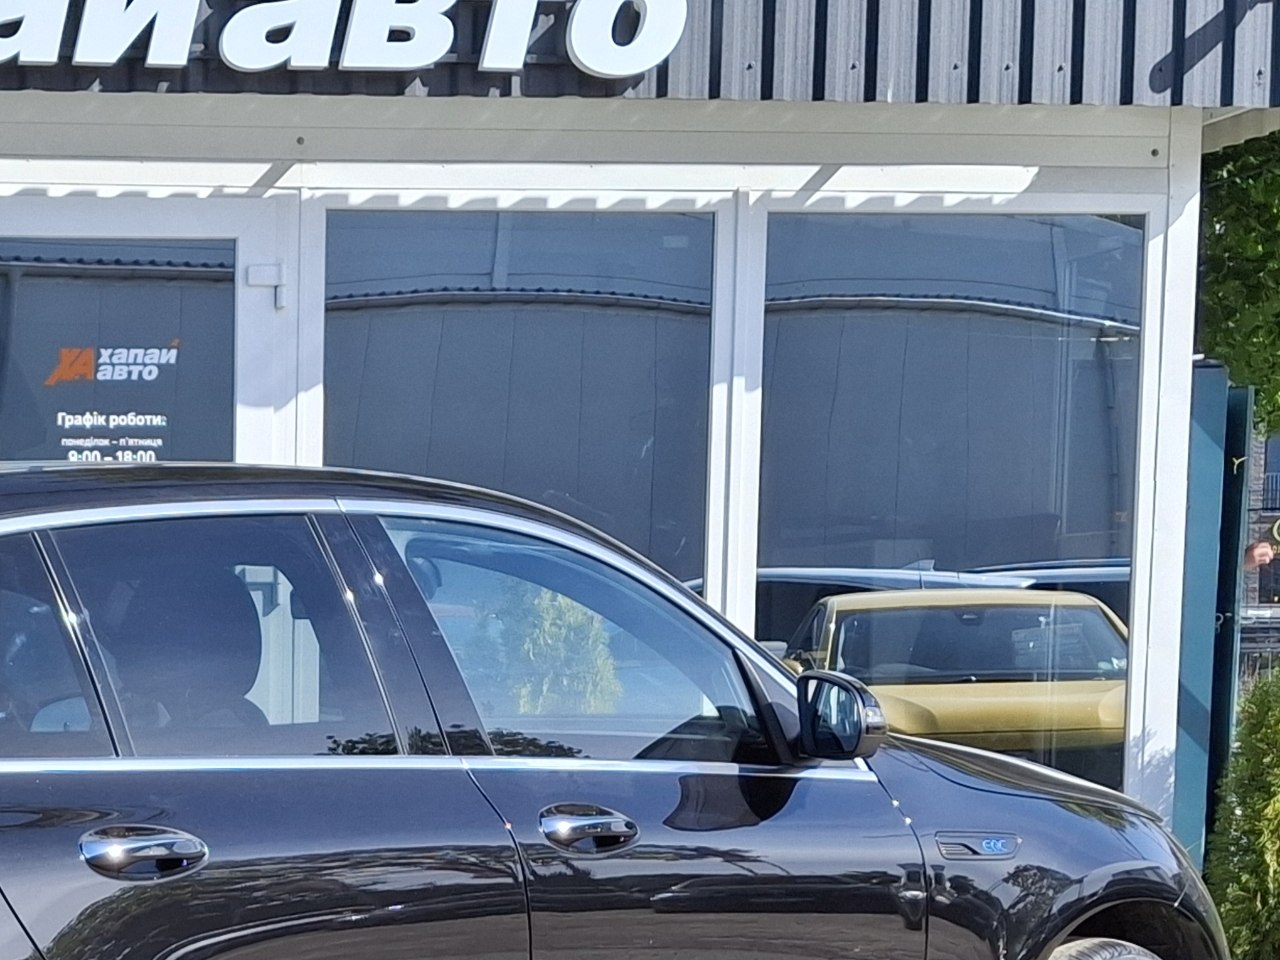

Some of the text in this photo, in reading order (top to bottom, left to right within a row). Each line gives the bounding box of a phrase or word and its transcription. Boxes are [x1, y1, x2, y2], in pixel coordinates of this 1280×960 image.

[97, 338, 181, 364] хапай
[96, 364, 160, 381] авто
[57, 411, 107, 429] Графік
[115, 450, 157, 462] 18:00
[982, 839, 1007, 852] EQC
